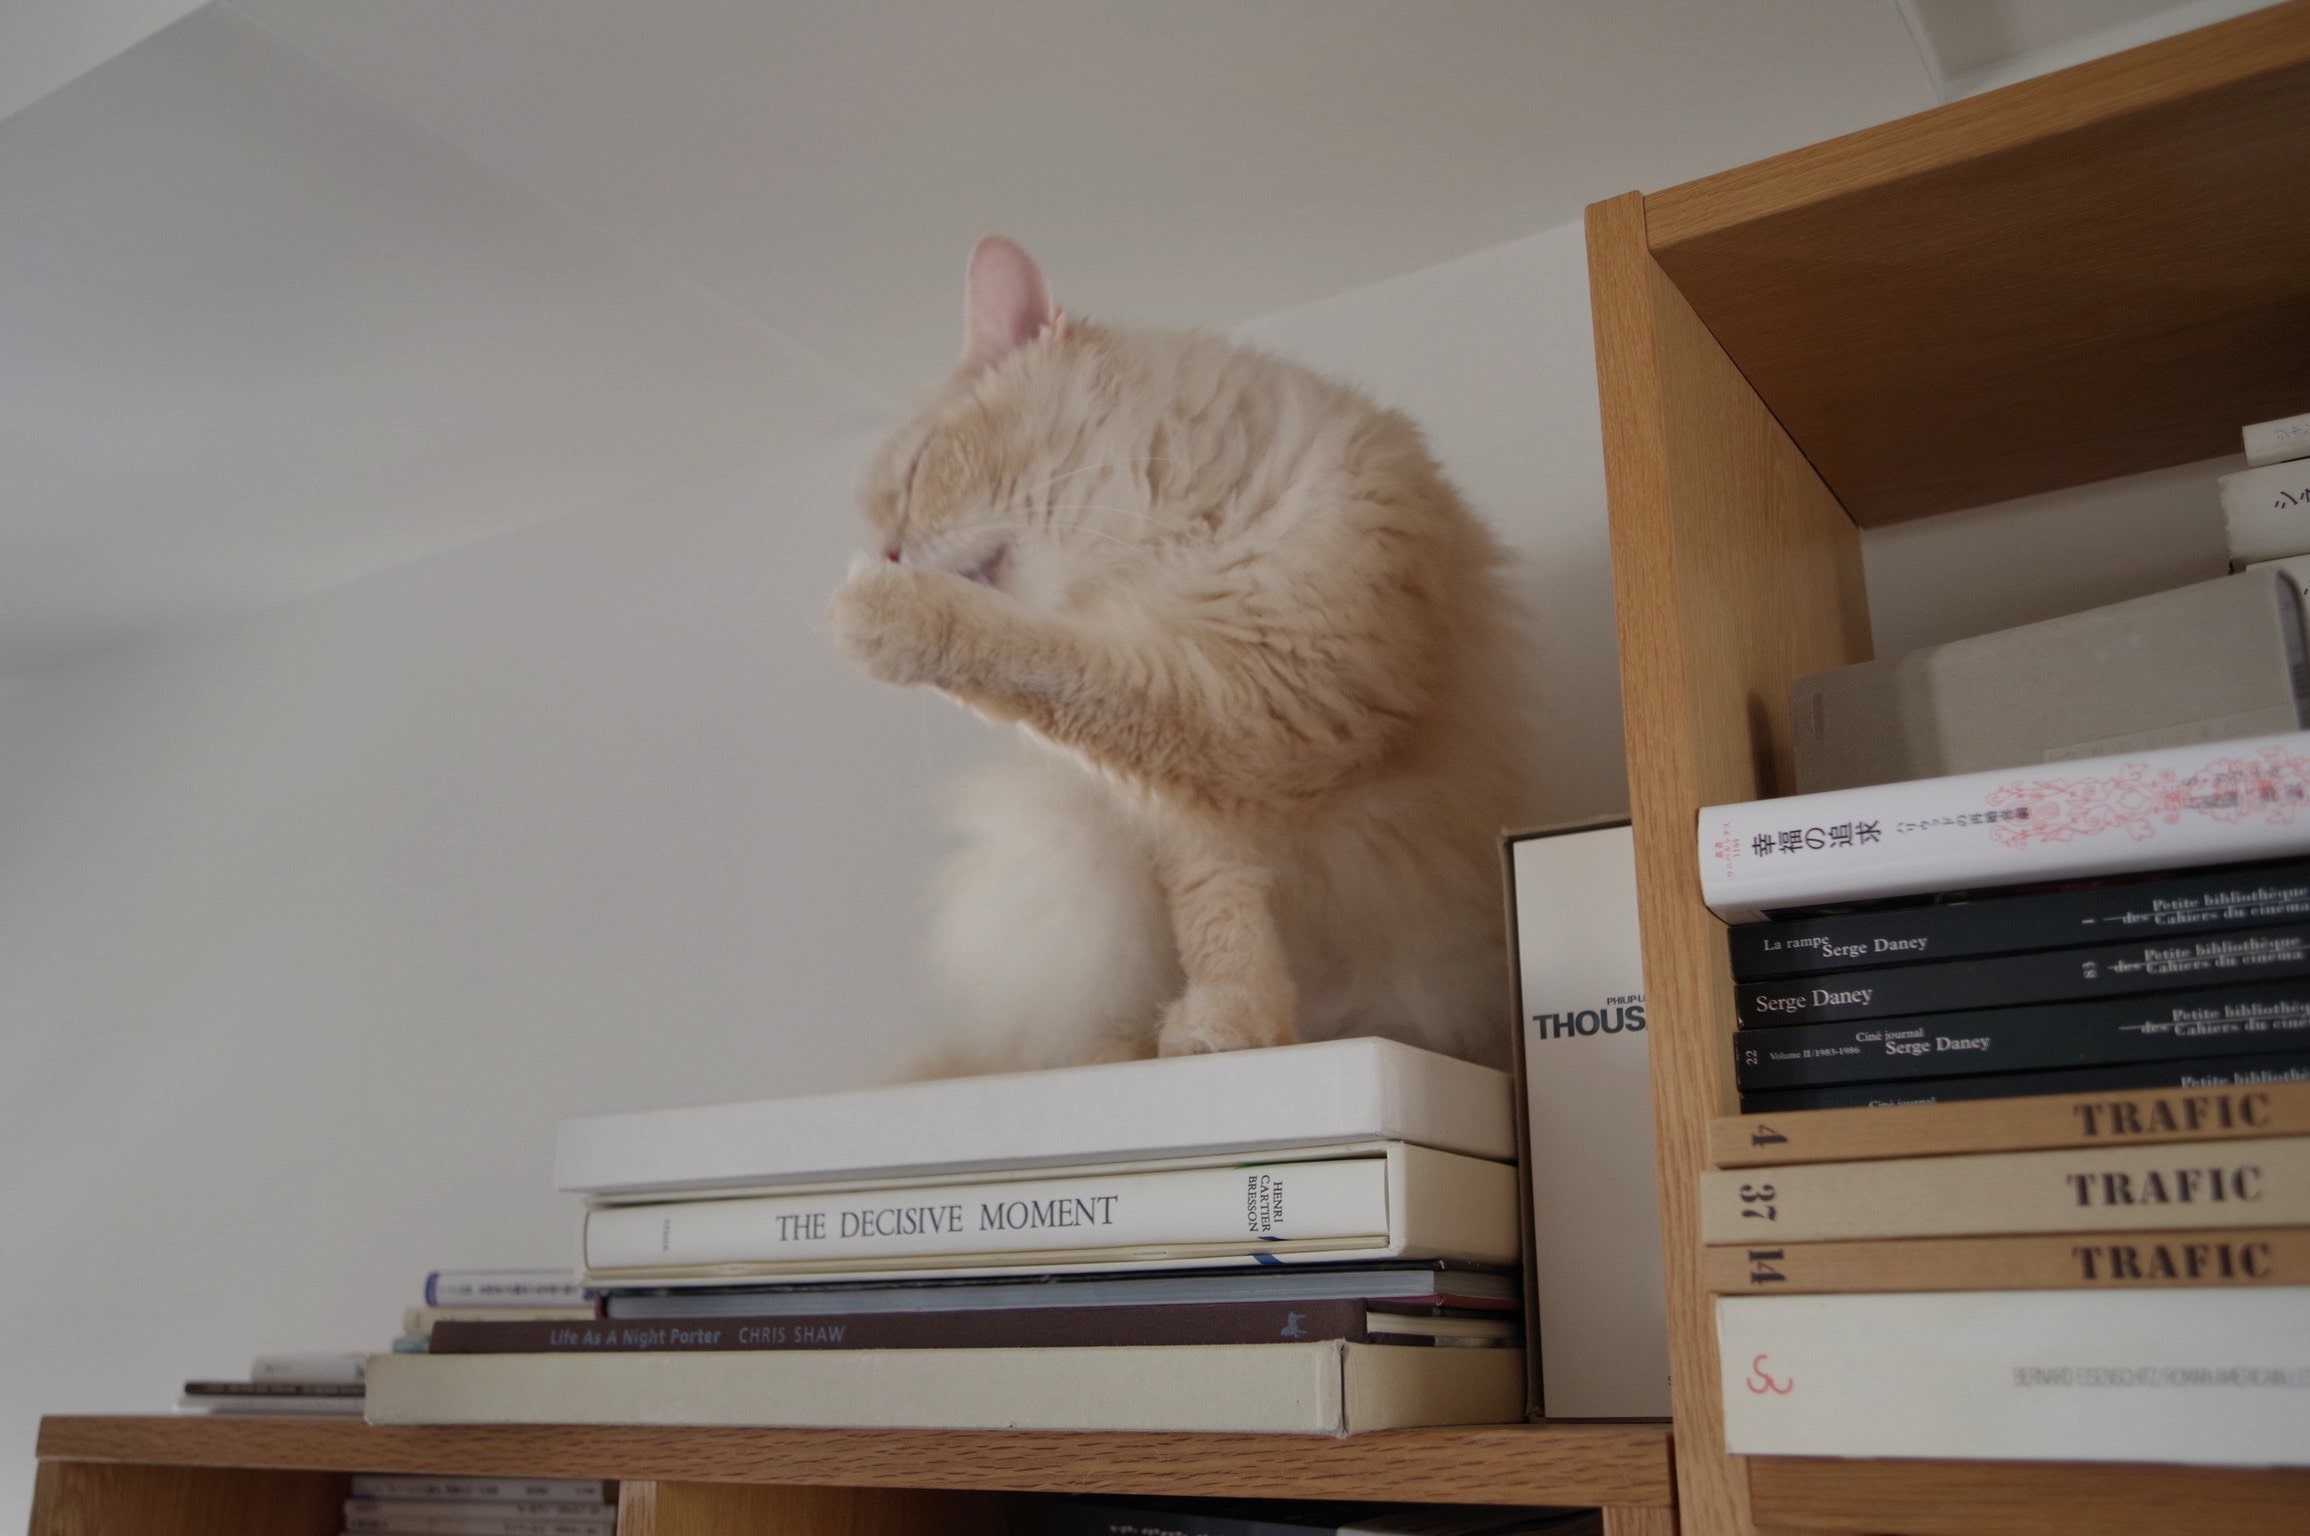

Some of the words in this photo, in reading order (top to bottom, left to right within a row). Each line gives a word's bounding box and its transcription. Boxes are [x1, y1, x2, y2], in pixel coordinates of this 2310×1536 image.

[1752, 819, 1883, 857] 幸福の追求
[2153, 899, 2200, 911] Petite
[2204, 887, 2308, 907] bibliothèque
[2122, 911, 2149, 924] des
[2154, 910, 2219, 925] Cahiers
[2223, 906, 2247, 919] du
[1764, 940, 1781, 951] La
[1787, 936, 1830, 949] rampe
[1822, 944, 1868, 958] Serge
[1873, 937, 1928, 952] Daney
[2144, 949, 2193, 961] Petite
[2195, 937, 2301, 957] bibliothèque
[2114, 960, 2142, 973] des
[2146, 959, 2211, 974] Cahiers
[2214, 954, 2240, 968] du
[1756, 995, 1807, 1013] Serge
[1811, 988, 1873, 1006] Daney
[1532, 1005, 1647, 1040] THOUS
[2141, 1021, 2170, 1034] des
[2174, 1021, 2241, 1037] Cahiers
[2244, 1017, 2269, 1031] du
[2173, 1008, 2222, 1022] Petite
[1856, 1031, 1882, 1043] Ciné
[1884, 1028, 1924, 1041] journal
[1885, 1041, 1930, 1056] Serge
[1936, 1036, 1991, 1052] Daney
[1770, 1051, 1801, 1060] Volume
[2073, 1093, 2272, 1136] TRAFIC
[1752, 1124, 1788, 1147] 4
[2066, 1164, 2262, 1206] TRAFIC
[1247, 1175, 1258, 1232] BRESSON
[1260, 1174, 1271, 1232] CARTIER
[1274, 1181, 1284, 1223] HENRI
[1740, 1184, 1776, 1222] 37
[776, 1214, 826, 1242] THE
[840, 1204, 964, 1239] DECISIVE
[979, 1195, 1119, 1232] MOMENT
[1749, 1249, 1787, 1285] 14
[2072, 1243, 2272, 1280] TRAFIC
[550, 1329, 579, 1345] Life
[583, 1329, 602, 1345] As
[606, 1329, 617, 1345] A
[622, 1328, 665, 1348] Night
[670, 1329, 721, 1344] Porter
[738, 1327, 786, 1343] CHRIS
[794, 1326, 846, 1343] SHAW
